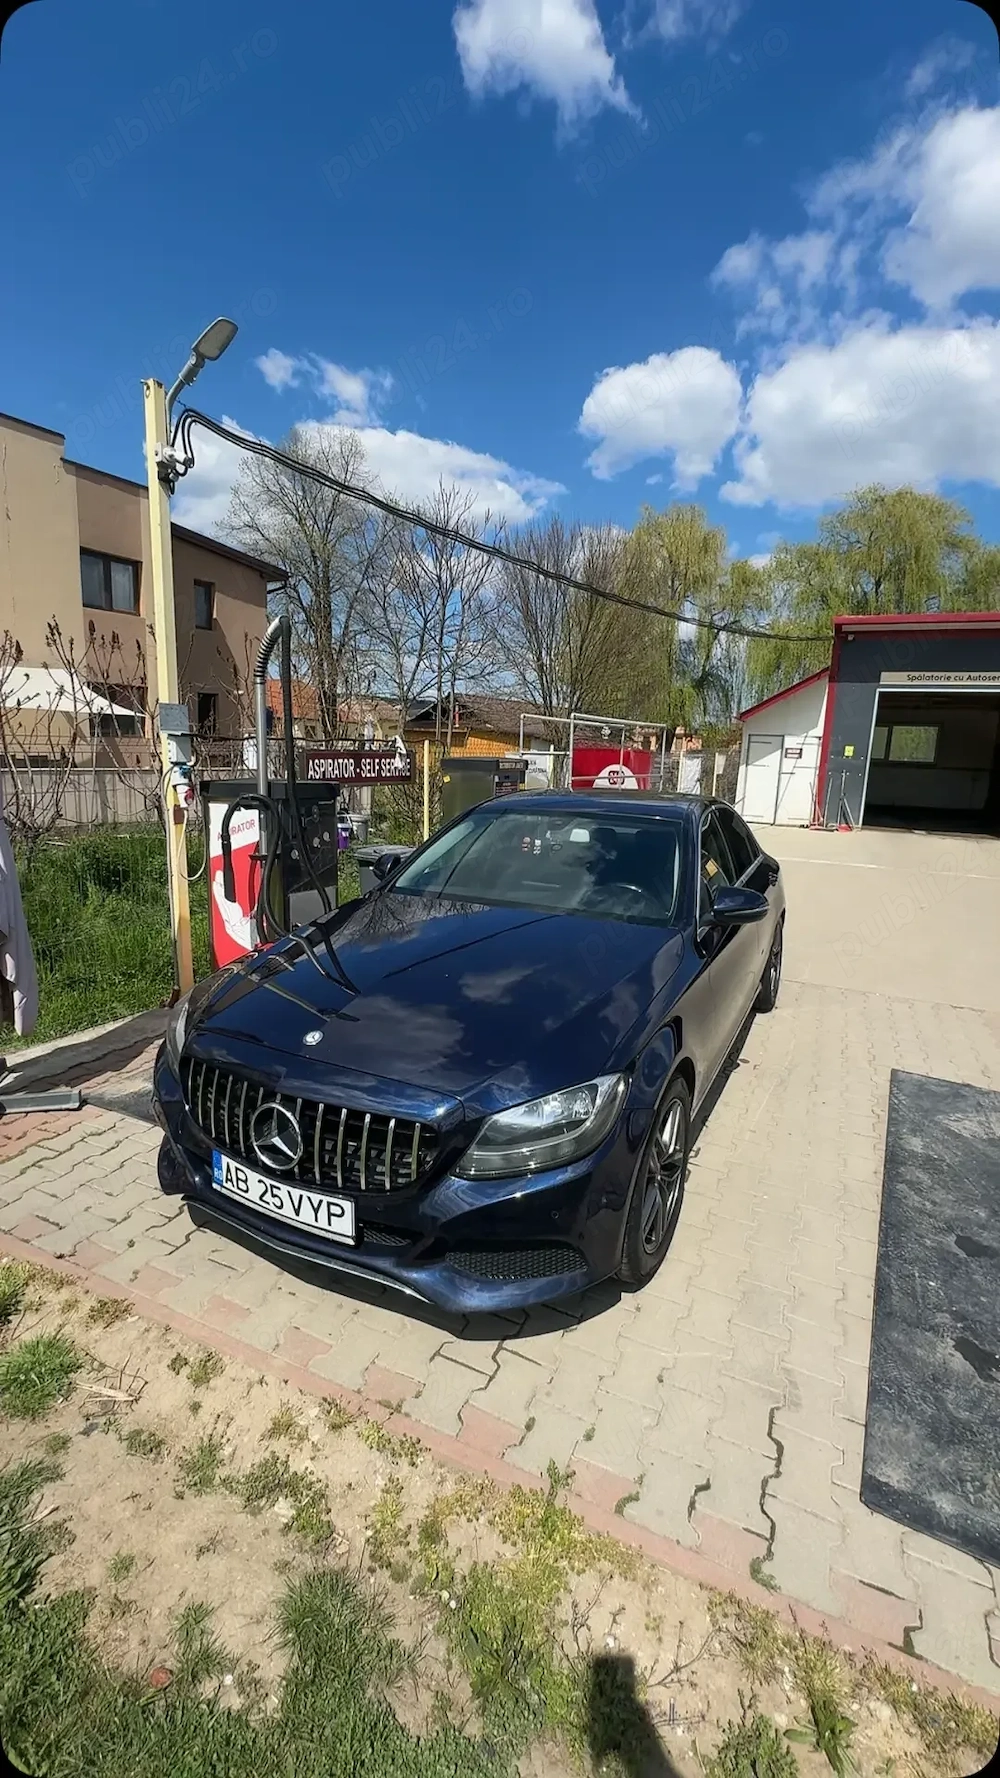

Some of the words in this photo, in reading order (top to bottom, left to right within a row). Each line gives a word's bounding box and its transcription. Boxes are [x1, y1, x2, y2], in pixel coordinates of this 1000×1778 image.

[308, 758, 355, 779] ASPIRATOR
[361, 758, 379, 778] SELF
[217, 819, 256, 841] AIRATOR
[213, 1169, 223, 1181] RO
[224, 1161, 250, 1194] AB
[257, 1179, 284, 1210] 25
[286, 1190, 345, 1227] VYP
